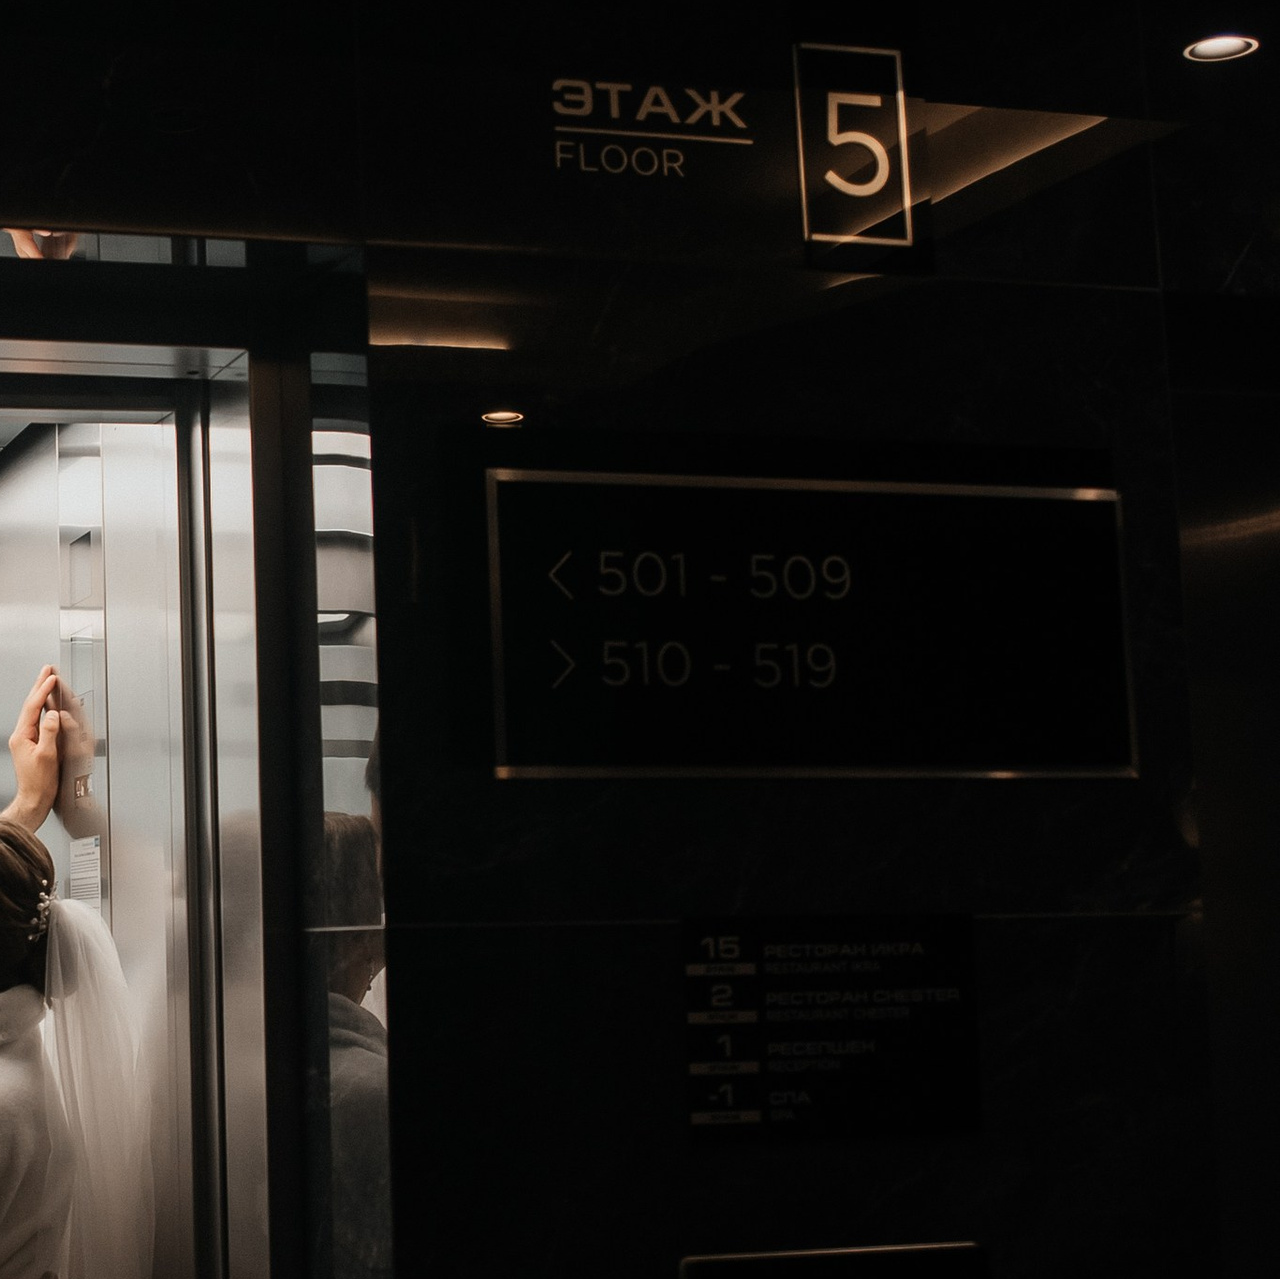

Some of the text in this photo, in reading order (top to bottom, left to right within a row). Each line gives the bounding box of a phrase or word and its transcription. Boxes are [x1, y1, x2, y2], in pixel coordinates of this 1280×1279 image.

[552, 78, 748, 129] ЭТАЖ
[824, 91, 890, 197] 5
[554, 141, 685, 177] FLOOR
[598, 550, 687, 598] 501
[748, 553, 853, 600] 509
[601, 640, 692, 688] 510
[753, 642, 837, 689] 519
[700, 935, 741, 960] 15
[763, 943, 866, 959] РЕСТОРАН
[710, 983, 734, 1008] 2
[765, 990, 869, 1006] РЕСТОРАН
[716, 1034, 733, 1058] 1
[708, 1083, 734, 1107] -1
[769, 1090, 812, 1105] СПА
